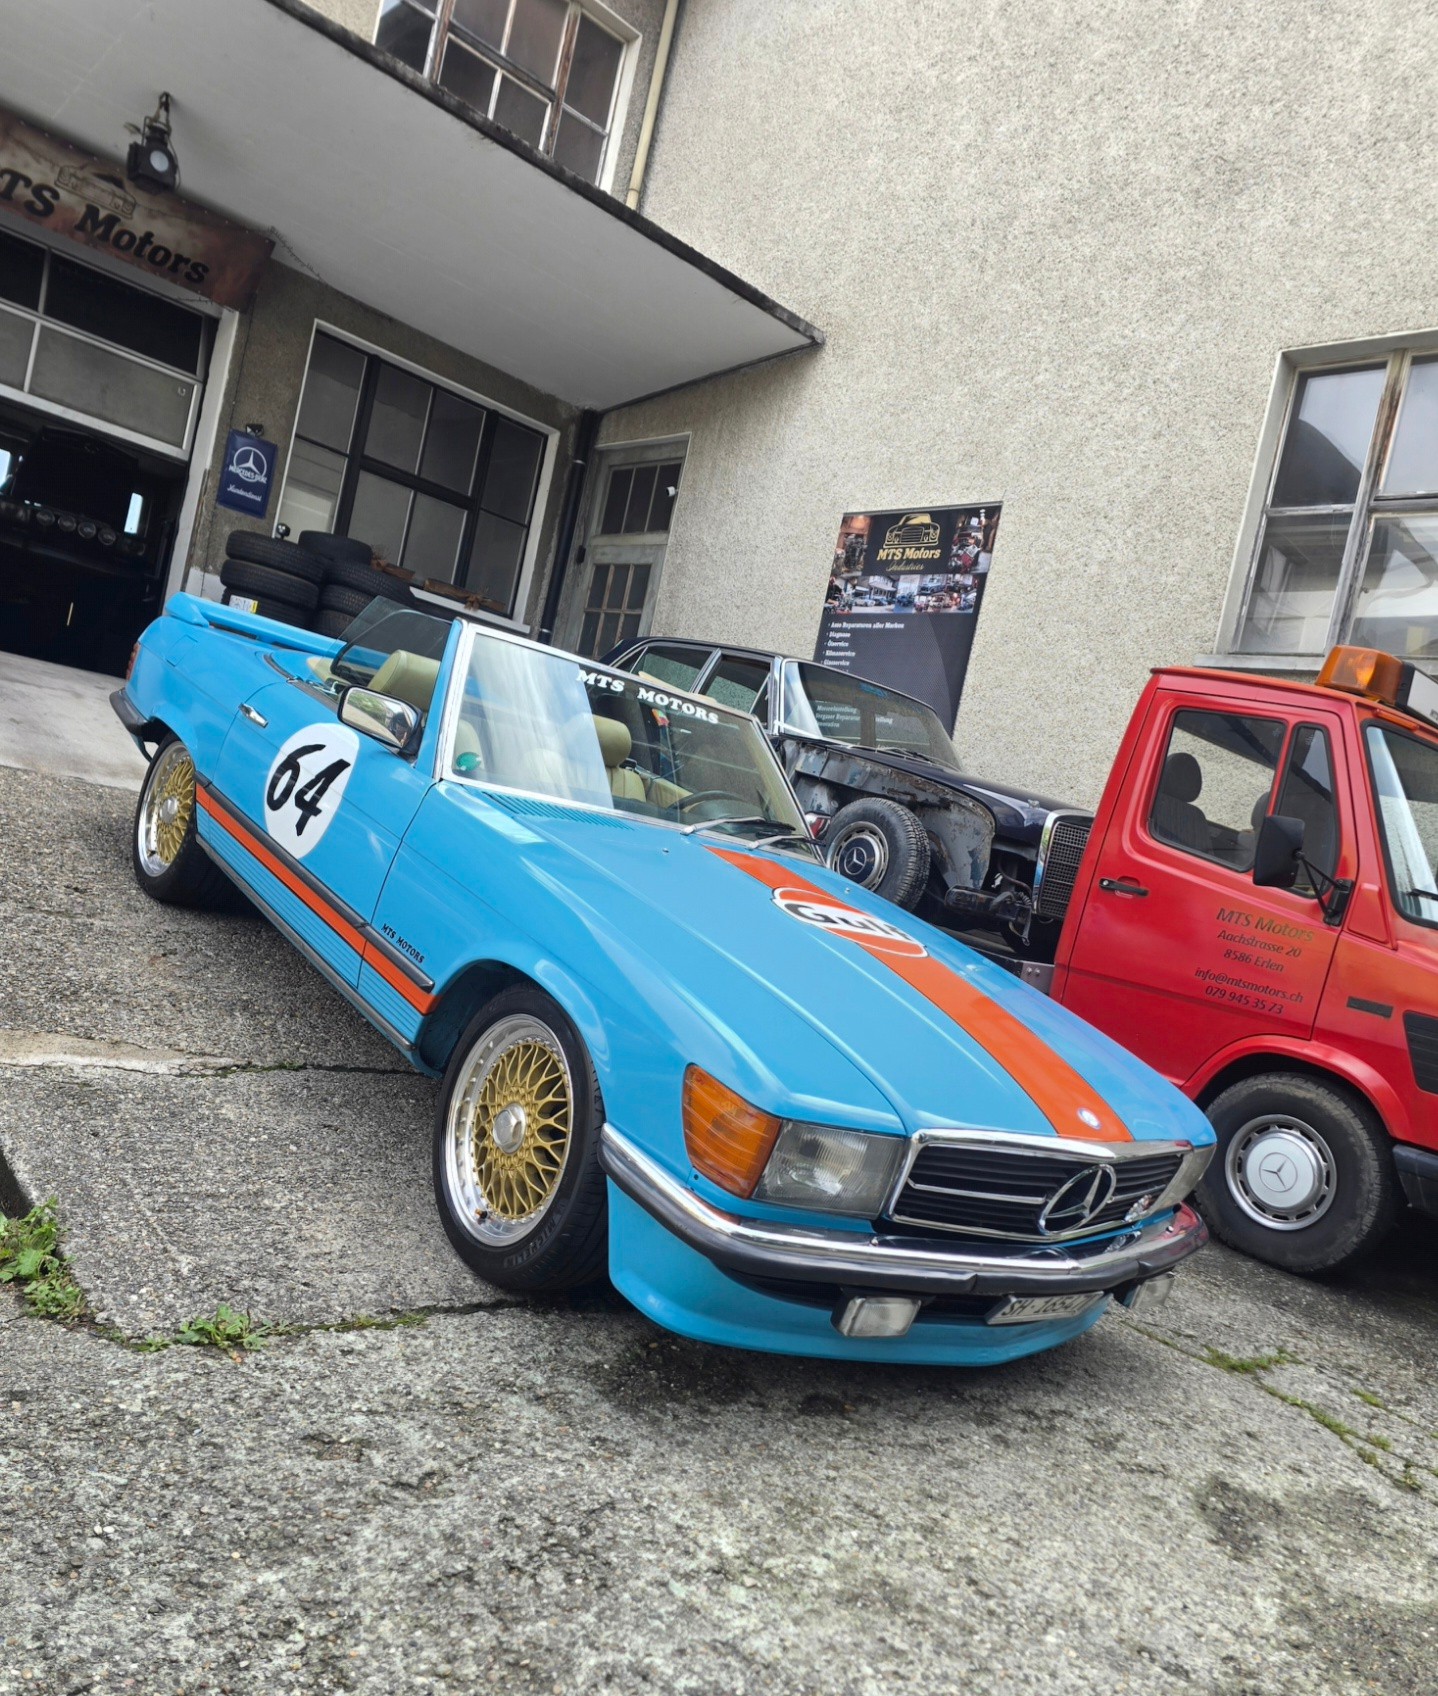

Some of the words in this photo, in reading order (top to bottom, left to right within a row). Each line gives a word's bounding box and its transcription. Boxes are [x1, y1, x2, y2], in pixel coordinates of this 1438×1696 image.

[74, 203, 210, 283] Motors
[228, 465, 268, 484] MERCEDES-BENZ
[877, 548, 903, 560] MTS
[903, 547, 942, 559] Motors
[576, 669, 625, 692] MTS
[637, 687, 719, 724] MOTORS
[266, 744, 351, 836] 64
[1216, 908, 1253, 927] MTS
[1255, 917, 1315, 942] Motors
[381, 923, 397, 939] MTS
[396, 936, 425, 963] MOTORS
[1217, 930, 1284, 954] Aachstrasse
[1285, 946, 1302, 958] 20
[1224, 949, 1252, 964] 8586
[1254, 956, 1284, 972] Erlen
[1195, 967, 1304, 1003] info@mtsmotors.ch
[1205, 985, 1227, 999] 079
[1229, 991, 1250, 1006] 945
[1252, 998, 1266, 1010] 35
[1268, 1003, 1284, 1015] 73
